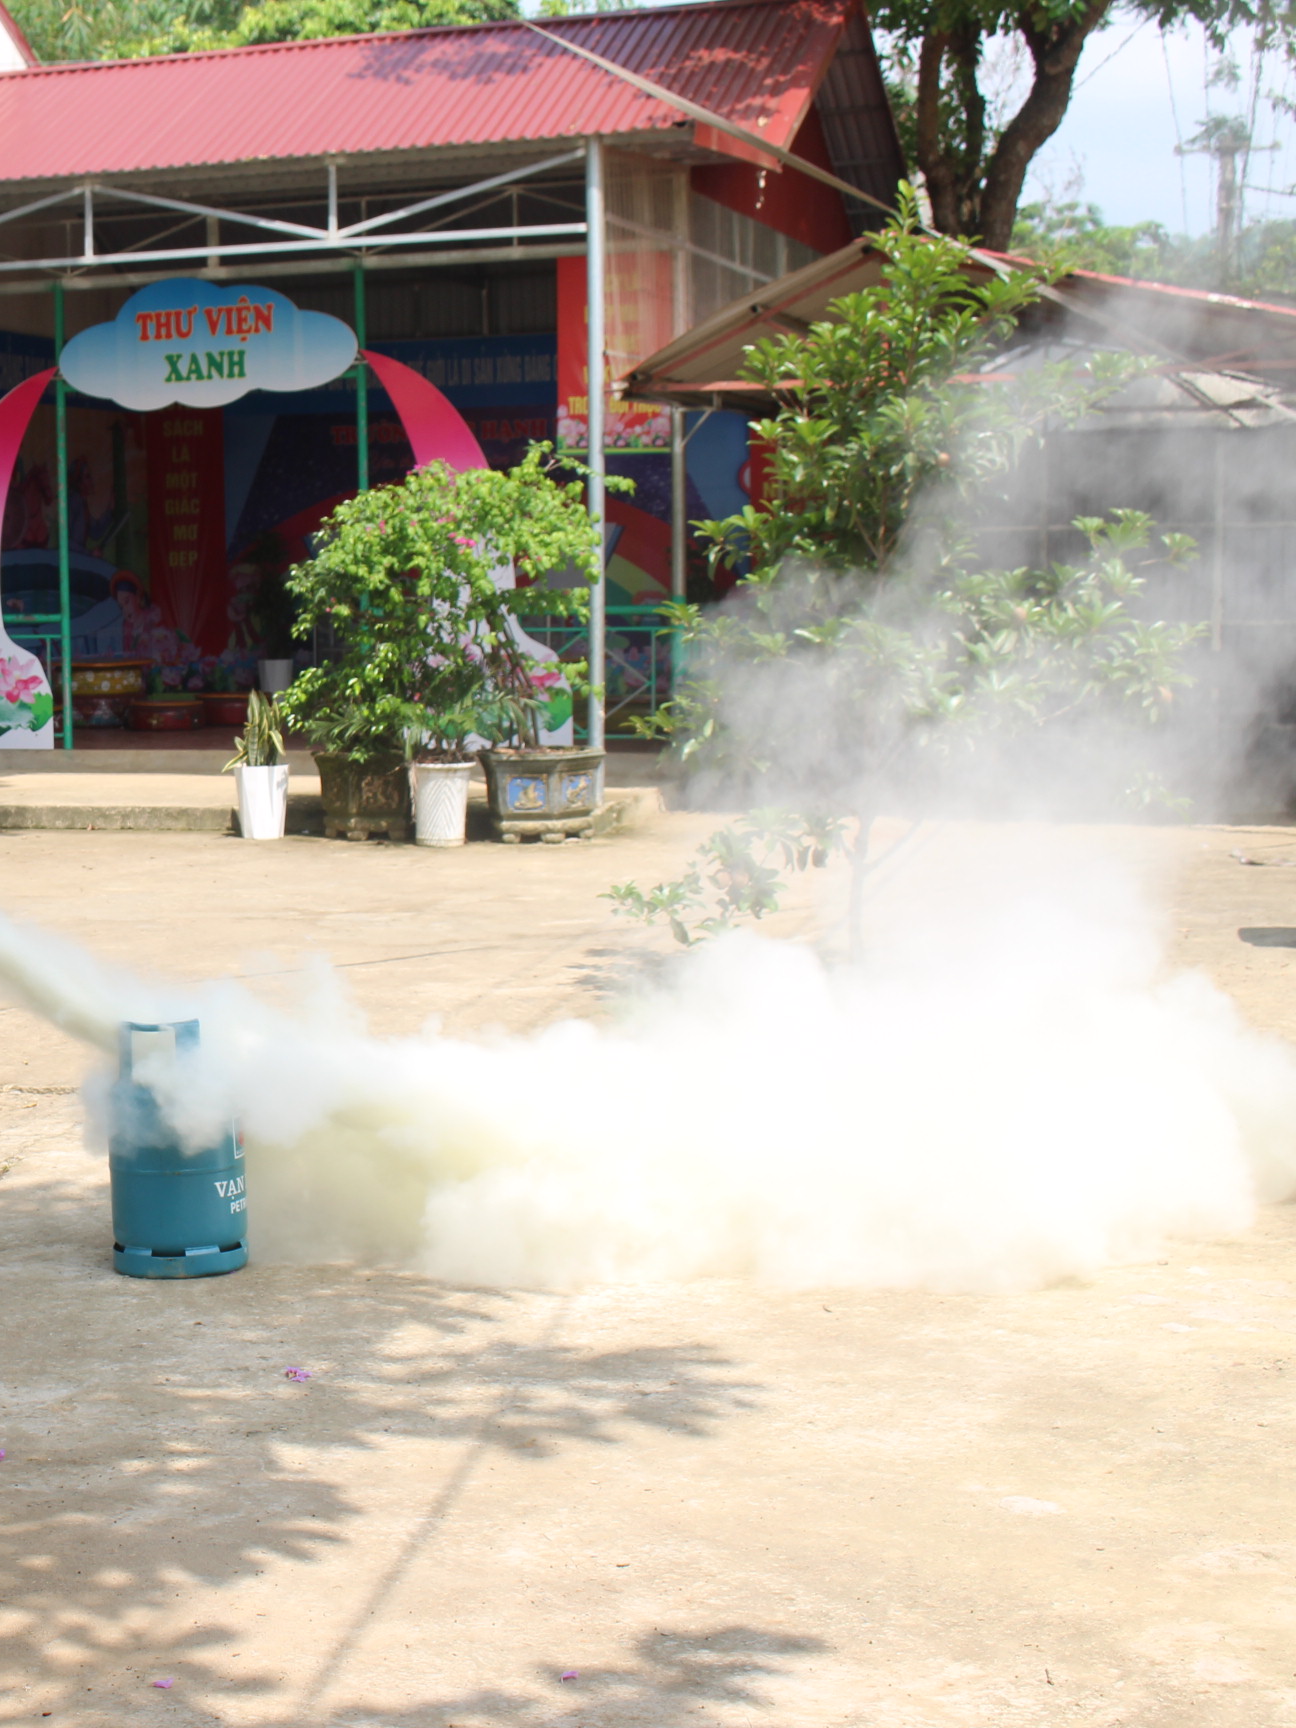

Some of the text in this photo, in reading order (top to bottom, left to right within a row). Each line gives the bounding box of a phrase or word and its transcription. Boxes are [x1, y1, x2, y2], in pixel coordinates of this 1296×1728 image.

[135, 295, 274, 342] THƯ VIỆN
[164, 348, 247, 383] XANH
[162, 417, 204, 437] SÁCH
